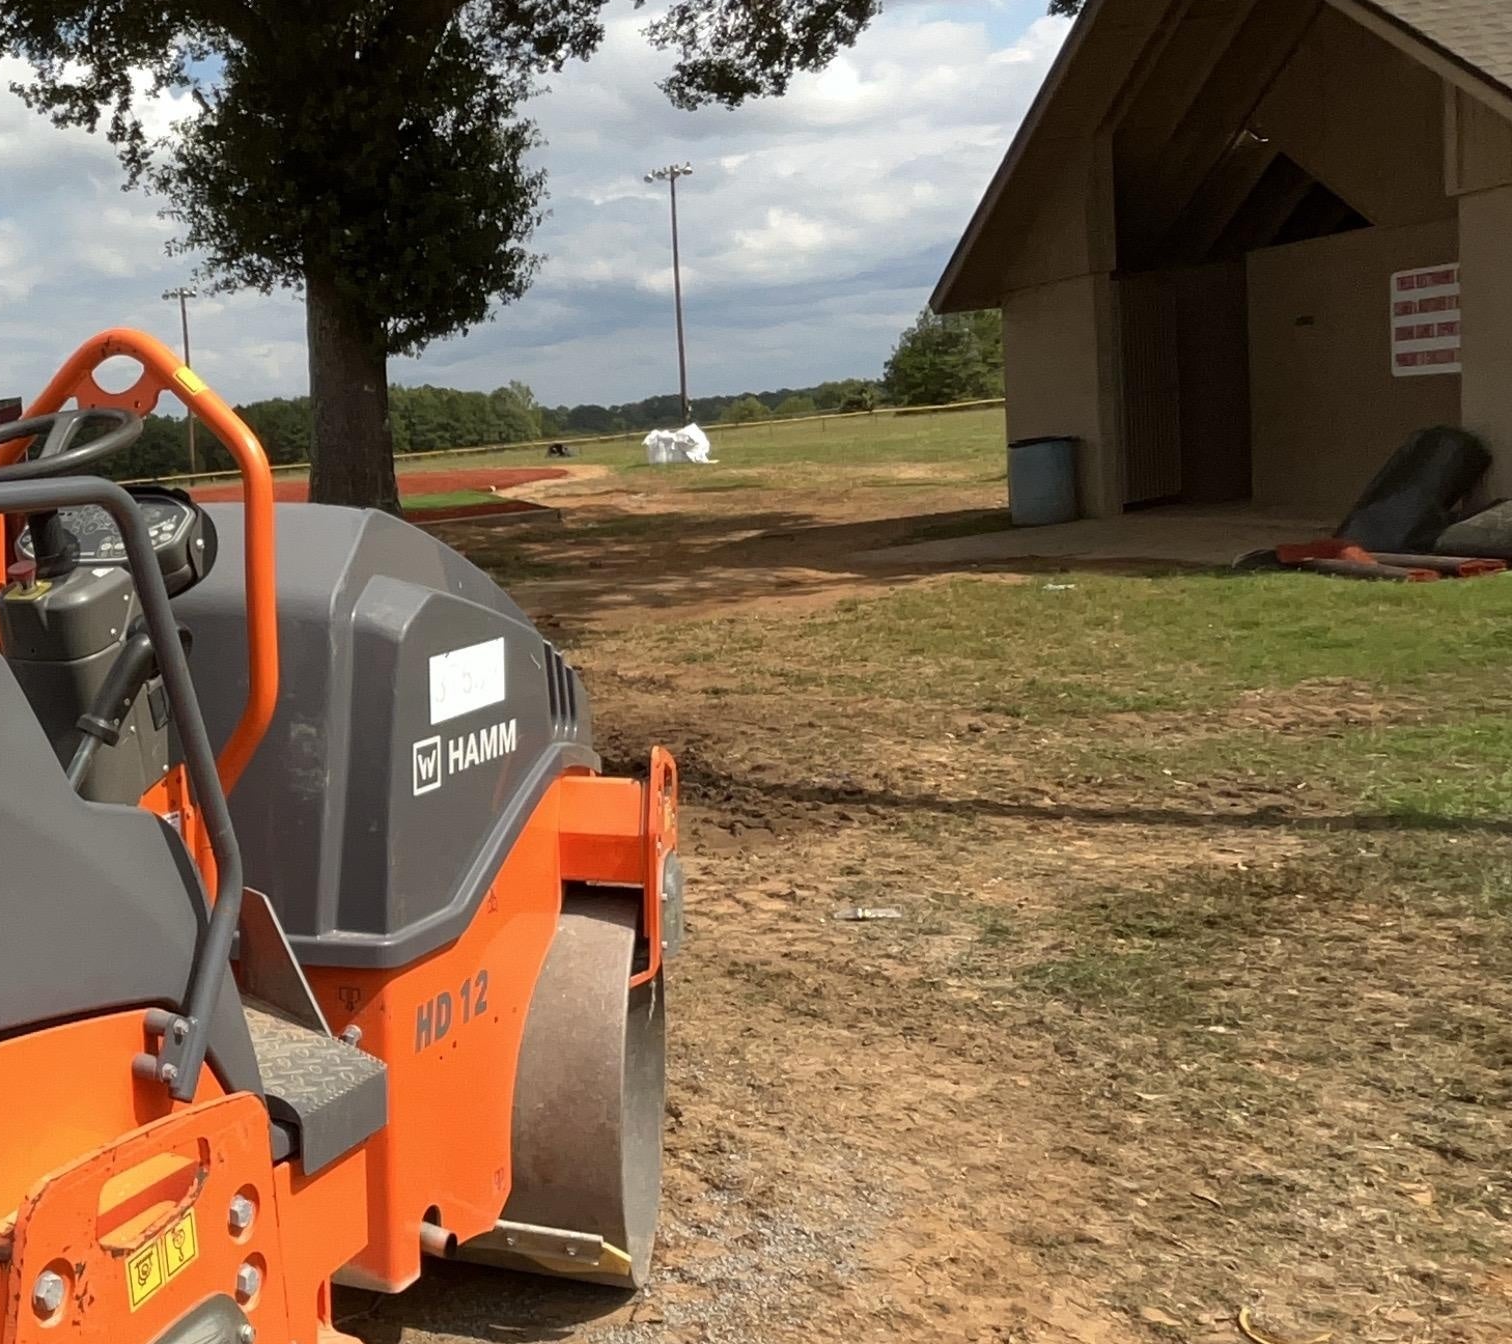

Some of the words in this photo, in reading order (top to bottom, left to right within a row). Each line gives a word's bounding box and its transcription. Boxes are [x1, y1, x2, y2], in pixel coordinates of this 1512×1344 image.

[448, 718, 517, 775] HAMM
[414, 991, 452, 1055] HD
[460, 968, 489, 1025] 12
